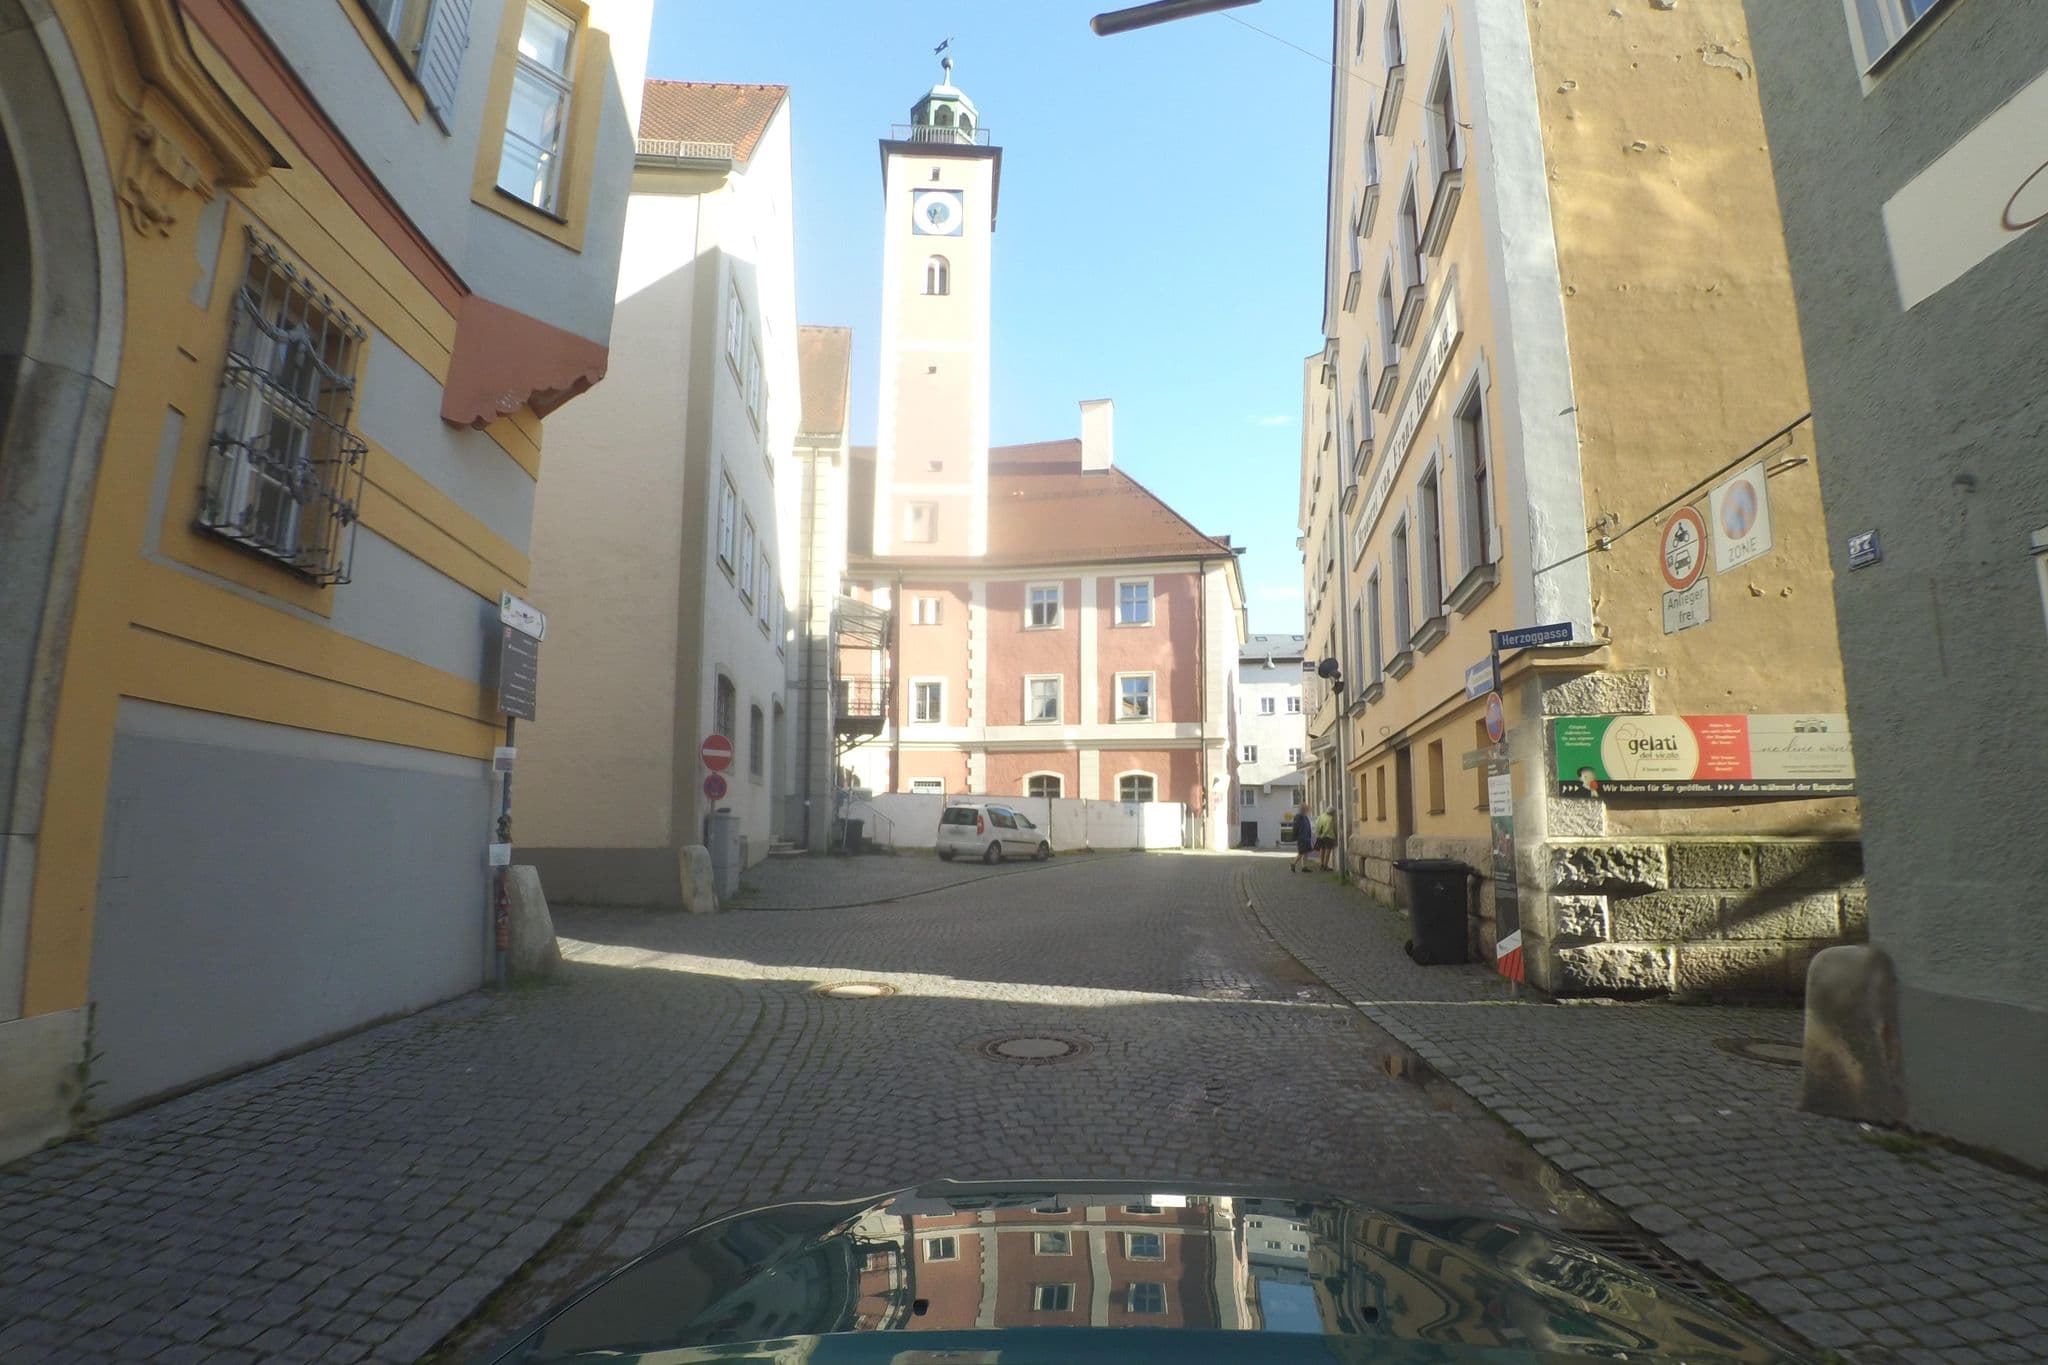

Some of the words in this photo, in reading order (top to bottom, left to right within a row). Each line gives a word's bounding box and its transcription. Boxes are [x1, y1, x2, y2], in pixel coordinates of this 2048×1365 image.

[1393, 411, 1413, 470] Franz
[1728, 536, 1758, 562] ZONE
[1668, 588, 1704, 609] Anlieger
[1680, 610, 1694, 622] frei
[1502, 628, 1568, 646] Herzoggasse
[1628, 735, 1678, 755] gelati
[1602, 784, 1618, 792] Wir
[1620, 783, 1646, 792] haben
[1647, 783, 1660, 792] für
[1662, 784, 1675, 792] Sie
[1738, 783, 1759, 791] Auch
[1797, 783, 1811, 791] der
